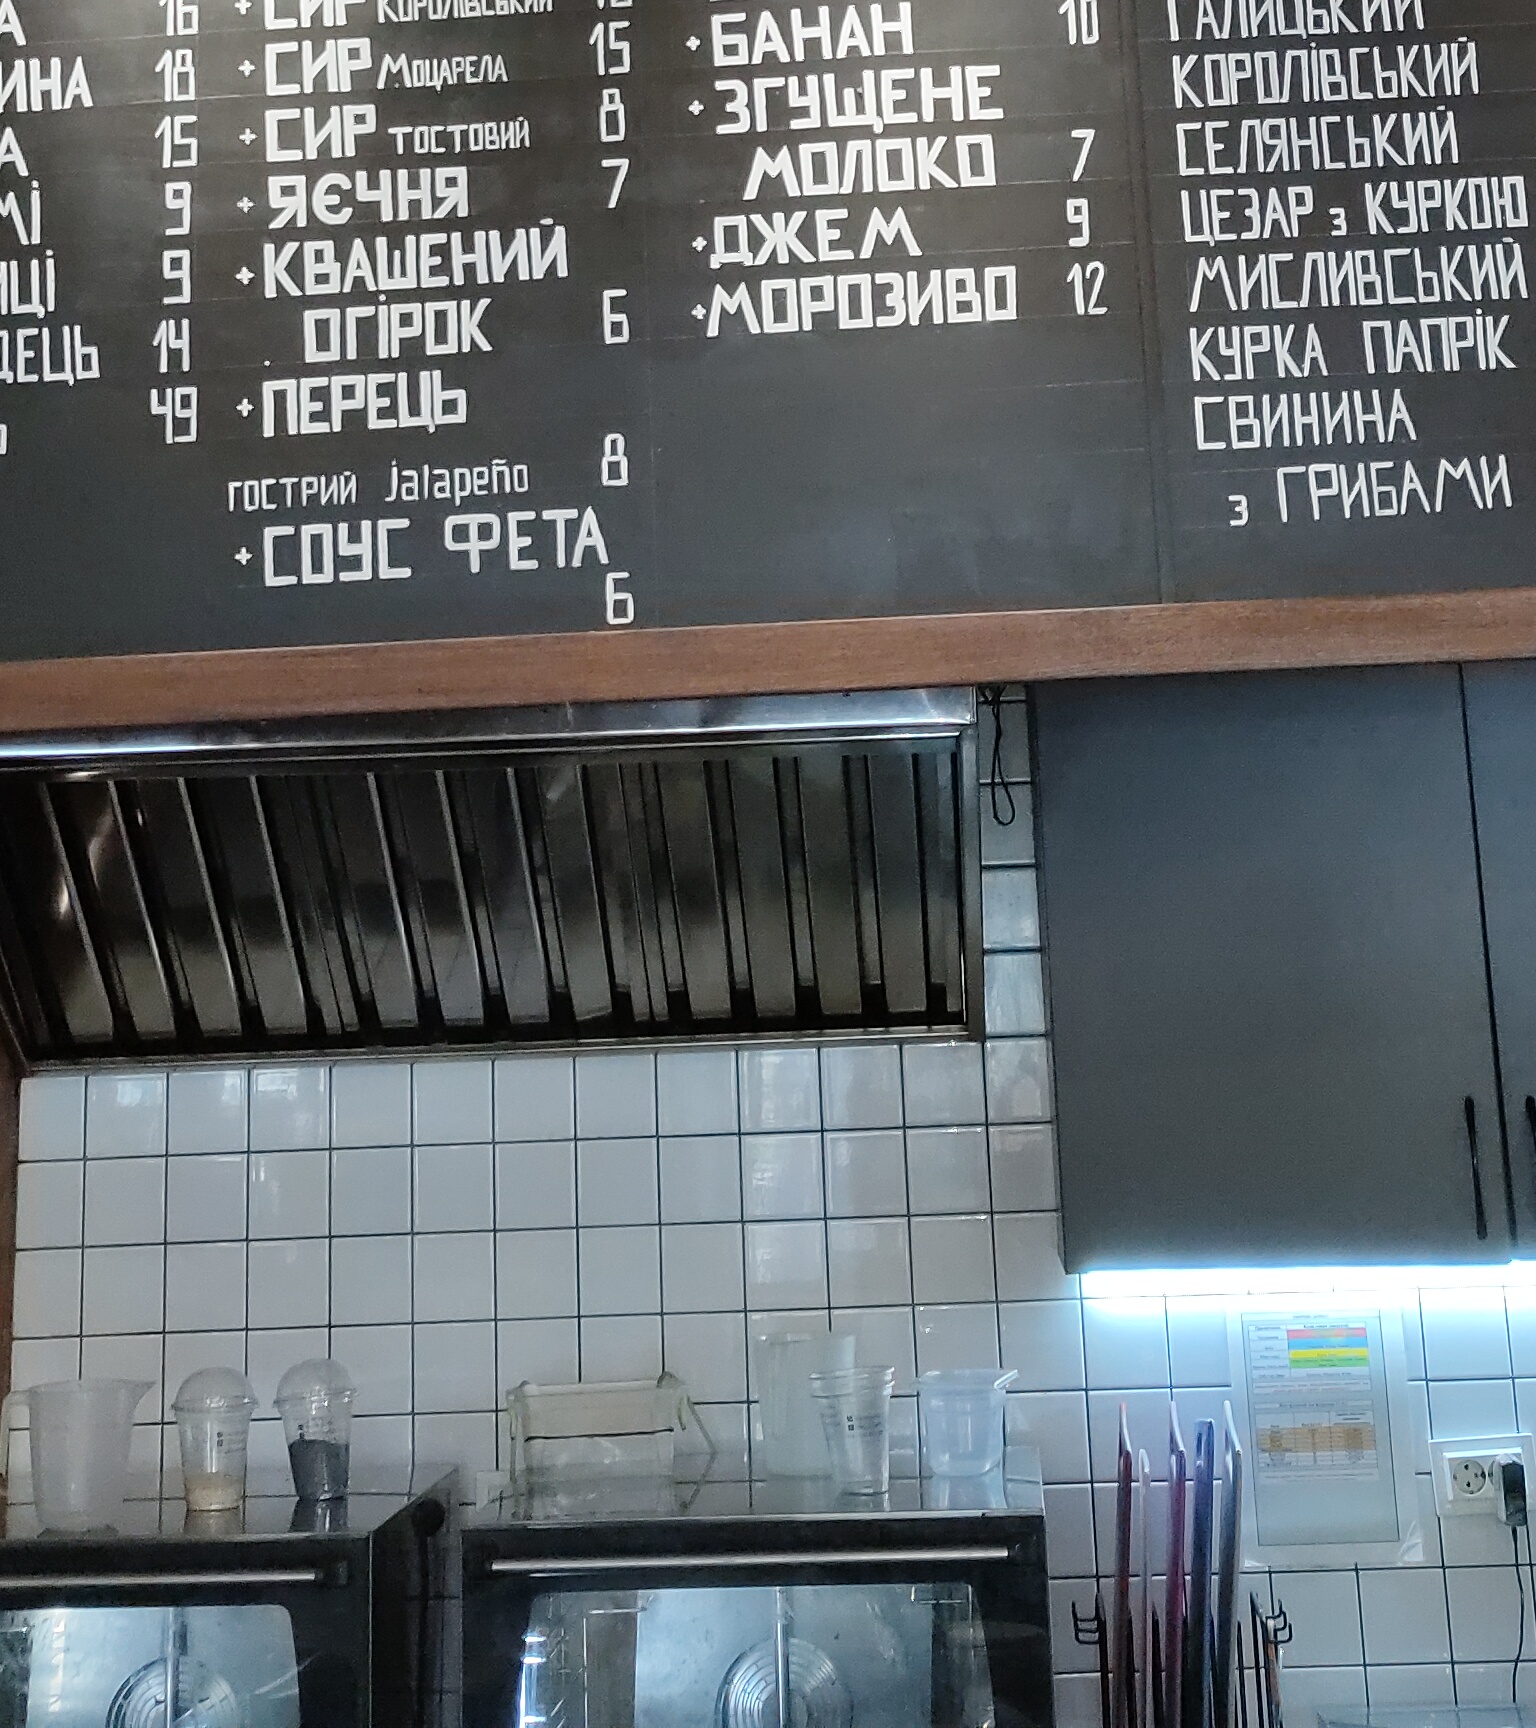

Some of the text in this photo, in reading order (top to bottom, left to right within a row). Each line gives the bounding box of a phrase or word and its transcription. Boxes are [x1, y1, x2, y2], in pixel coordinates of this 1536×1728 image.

[264, 37, 373, 97] СИР
[588, 20, 631, 76] 15
[710, 1, 915, 67] БАНАН
[154, 48, 196, 103] 18
[713, 64, 1004, 135] ЗГУЩЕНЕ
[1172, 36, 1480, 111] КОРОЛІВСЬКИЙ
[154, 114, 199, 169] 15
[264, 103, 377, 163] СИР
[742, 128, 1096, 201] МОЛОКО 7
[1175, 105, 1459, 177] СЕЛЯНСЬКИЙ
[164, 181, 192, 236] 9
[267, 157, 630, 230] ЯЄЧНЯ 7
[1180, 185, 1314, 247] ЦЕЗАР
[1364, 175, 1529, 235] КУРКОЮ
[262, 217, 569, 303] КВАШЕНИЙ
[709, 197, 1090, 270] ДЖЕМ 9
[162, 249, 192, 306] 9
[706, 260, 1108, 338] МОРОЗИВО 12
[1188, 236, 1529, 315] МИСЛИВСЬКИЙ
[152, 317, 191, 374] 14
[302, 288, 630, 364] ОГІРОК 6
[1189, 322, 1329, 382] КУРКА
[1362, 307, 1518, 375] ПАПРІК
[150, 386, 198, 445] 49
[261, 369, 467, 438] ПЕРЕЦЬ
[1193, 388, 1417, 451] СВИНИНА
[1276, 453, 1513, 523] ГРИБАМИ
[262, 505, 610, 587] СОУС ФЕТА
